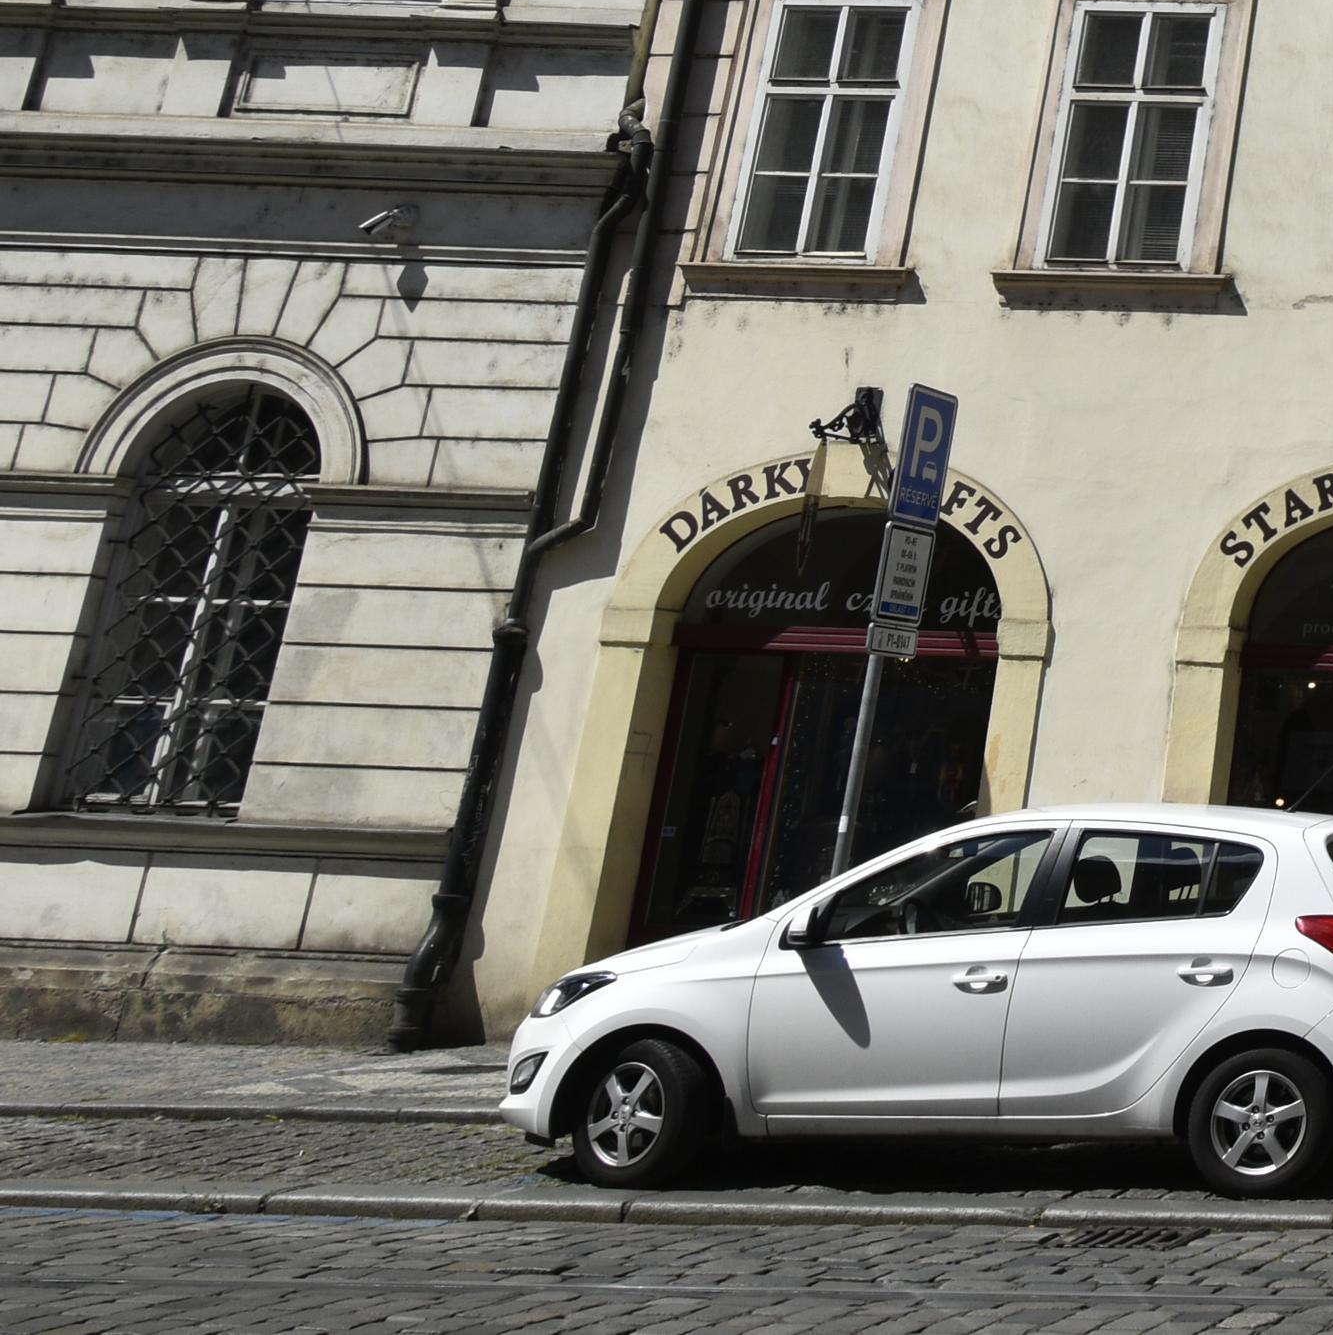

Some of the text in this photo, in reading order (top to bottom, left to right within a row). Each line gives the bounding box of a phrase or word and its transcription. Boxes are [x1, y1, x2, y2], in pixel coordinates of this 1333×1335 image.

[909, 406, 943, 478] P
[900, 486, 939, 508] RÉSERVÉ
[706, 582, 831, 617] original
